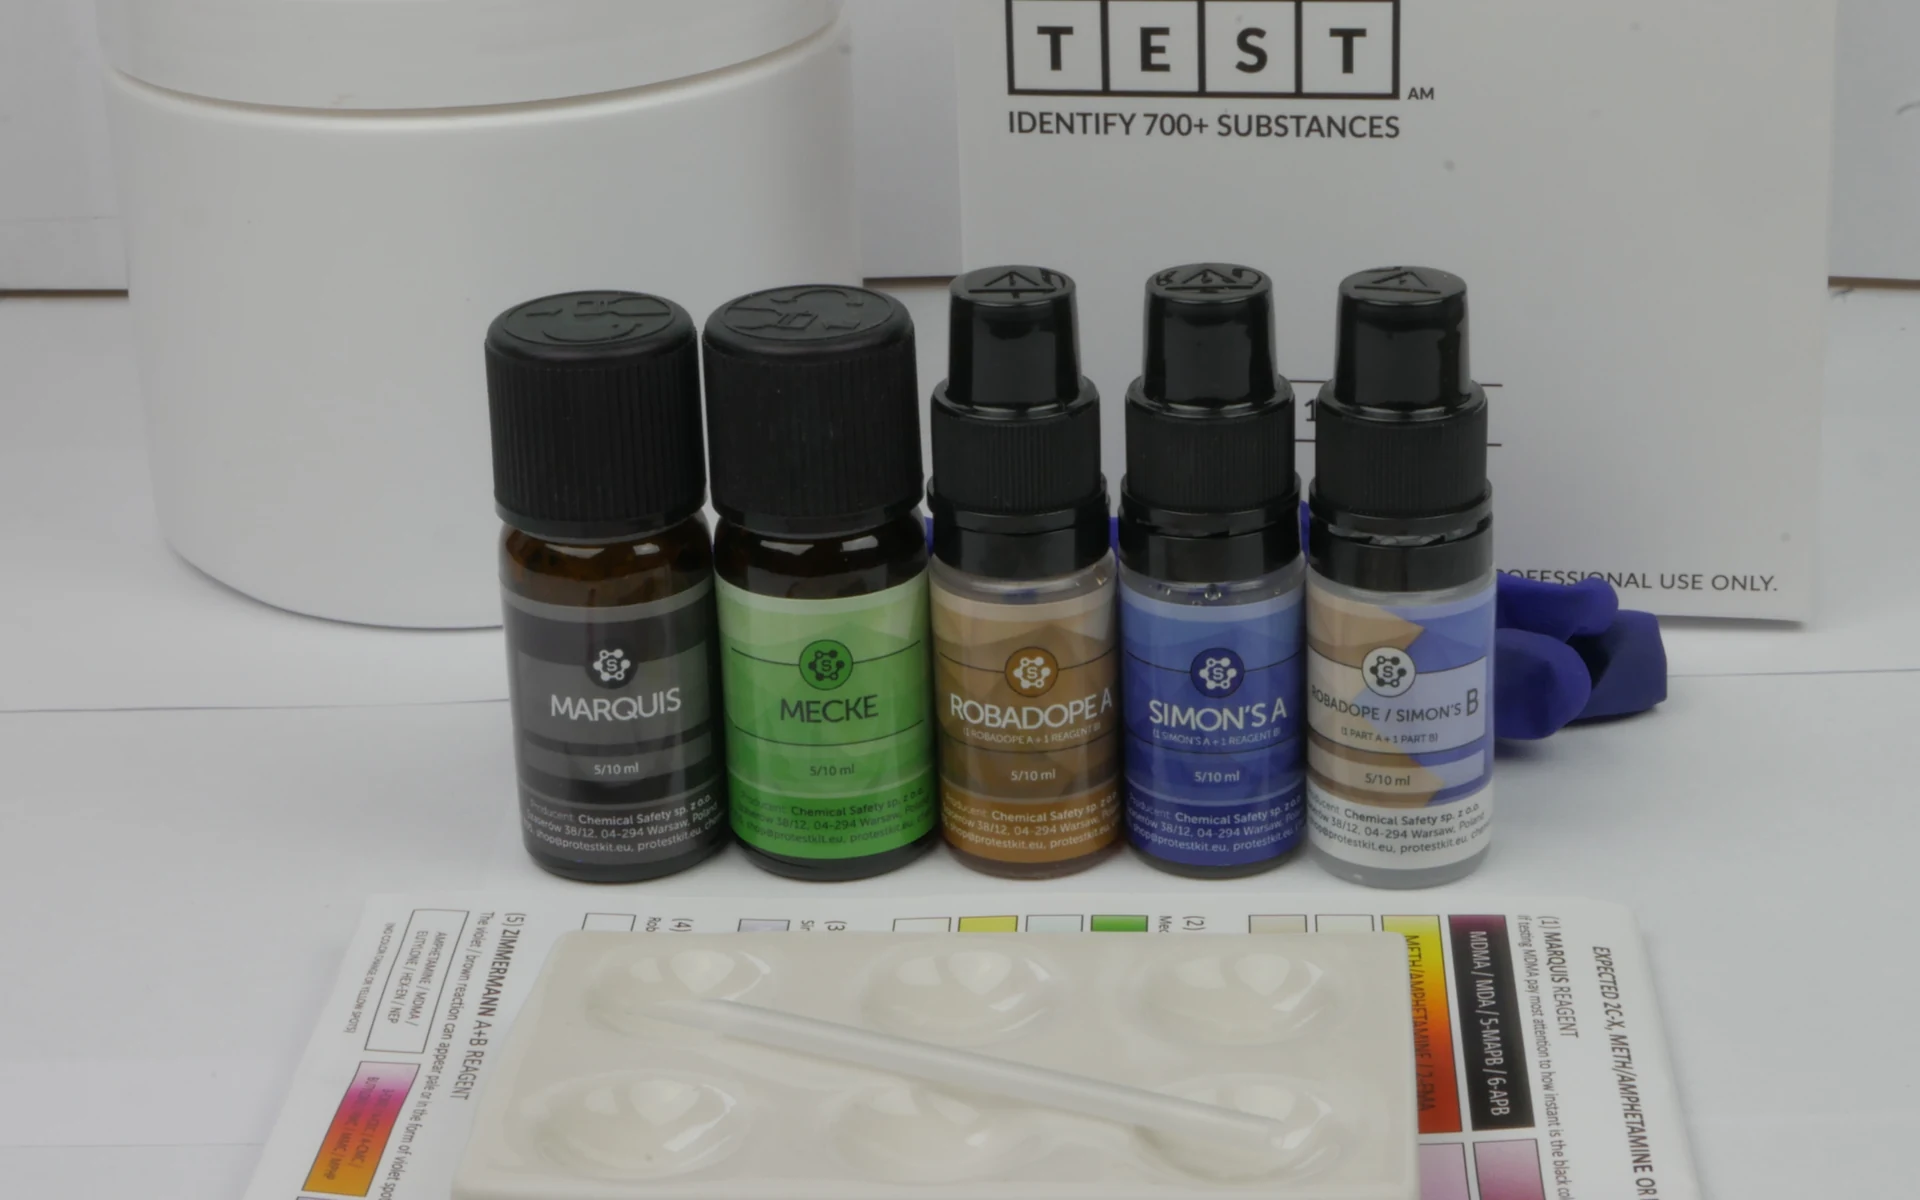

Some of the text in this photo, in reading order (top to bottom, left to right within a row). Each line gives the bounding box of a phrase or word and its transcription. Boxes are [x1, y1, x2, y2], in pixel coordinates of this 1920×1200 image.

[1407, 87, 1435, 101] AM
[1008, 111, 1401, 139] IDENTIFY 700+ SUBSTANCES
[1660, 573, 1704, 590] USE
[1711, 574, 1779, 591] ONLY.
[550, 687, 682, 722] MARQUIS
[779, 694, 880, 724] MECKE
[950, 687, 1113, 730] ROBADOPE A
[1311, 684, 1381, 721] ROBADOPE
[1466, 687, 1479, 717] B
[1149, 697, 1288, 732] SIMON'S A
[970, 729, 1024, 745] ROBADOPE
[1026, 735, 1034, 745] A
[1051, 725, 1093, 743] REAGENT
[1202, 737, 1211, 747] A
[1229, 731, 1271, 745] REAGENT
[1350, 728, 1373, 741] PART
[1375, 733, 1383, 743] A
[1393, 733, 1398, 743] 1
[1401, 732, 1426, 743] PART
[594, 762, 639, 776] 5/10 ml
[809, 763, 855, 777] 5/10 ml
[1010, 769, 1056, 782] 5/10 ml
[1194, 770, 1240, 783] 5/10 ml
[1365, 772, 1411, 787] 5/10 ml
[578, 813, 633, 826] Chemical
[636, 809, 672, 824] Safety
[791, 806, 846, 818] Chemical
[849, 803, 884, 816] Safety
[991, 810, 1047, 823] Chemical
[1050, 807, 1084, 821] Safety
[1175, 811, 1231, 825] Chemical
[1233, 811, 1268, 825] Safety
[1344, 808, 1398, 826] Chemical
[1401, 815, 1438, 827] Safety
[1440, 812, 1455, 824] sp.
[601, 827, 644, 839] 04-294
[814, 819, 856, 831] 04-294
[1197, 827, 1240, 839] 04-294
[1364, 826, 1407, 839] 04-294
[477, 912, 495, 925] The
[645, 916, 662, 932] Rob
[668, 918, 694, 932] (4)
[824, 920, 848, 931] (3
[1182, 915, 1206, 931] (2)
[469, 926, 488, 948] violet
[1517, 922, 1535, 948] testing
[405, 930, 429, 966] EUTYLONE
[1469, 930, 1491, 969] MDMA
[419, 931, 448, 984] AMPHETAMINE
[1522, 949, 1540, 978] MDMA
[458, 954, 481, 982] brown
[1536, 915, 1579, 1038] (1) MARQUIS REAGENT
[1475, 979, 1496, 1008] MDA
[1524, 979, 1539, 994] pay
[408, 991, 427, 1020] MDMA
[447, 983, 467, 1021] reaction
[449, 912, 527, 1100] (5) ZIMMERMANN A+B REAGENT
[1529, 995, 1544, 1017] most
[387, 1007, 402, 1024] NEP
[441, 1022, 456, 1040] can
[1533, 1018, 1551, 1058] attention
[1480, 1018, 1504, 1066] 5-MAPB
[431, 1042, 450, 1074] appear
[1539, 1059, 1552, 1069] to
[1592, 946, 1657, 1196] EXPECTED 2C-X, METH/AMPHETAMINE OR
[423, 1074, 441, 1091] pale
[1540, 1071, 1556, 1092] how
[420, 1091, 432, 1100] or
[1487, 1077, 1510, 1116] 6-APB
[409, 1109, 428, 1122] the
[1544, 1093, 1560, 1127] instant
[400, 1123, 423, 1144] form
[1549, 1129, 1564, 1138] is
[396, 1144, 412, 1156] of
[1550, 1140, 1567, 1157] the
[386, 1156, 408, 1181] violet
[1553, 1160, 1572, 1186] black
